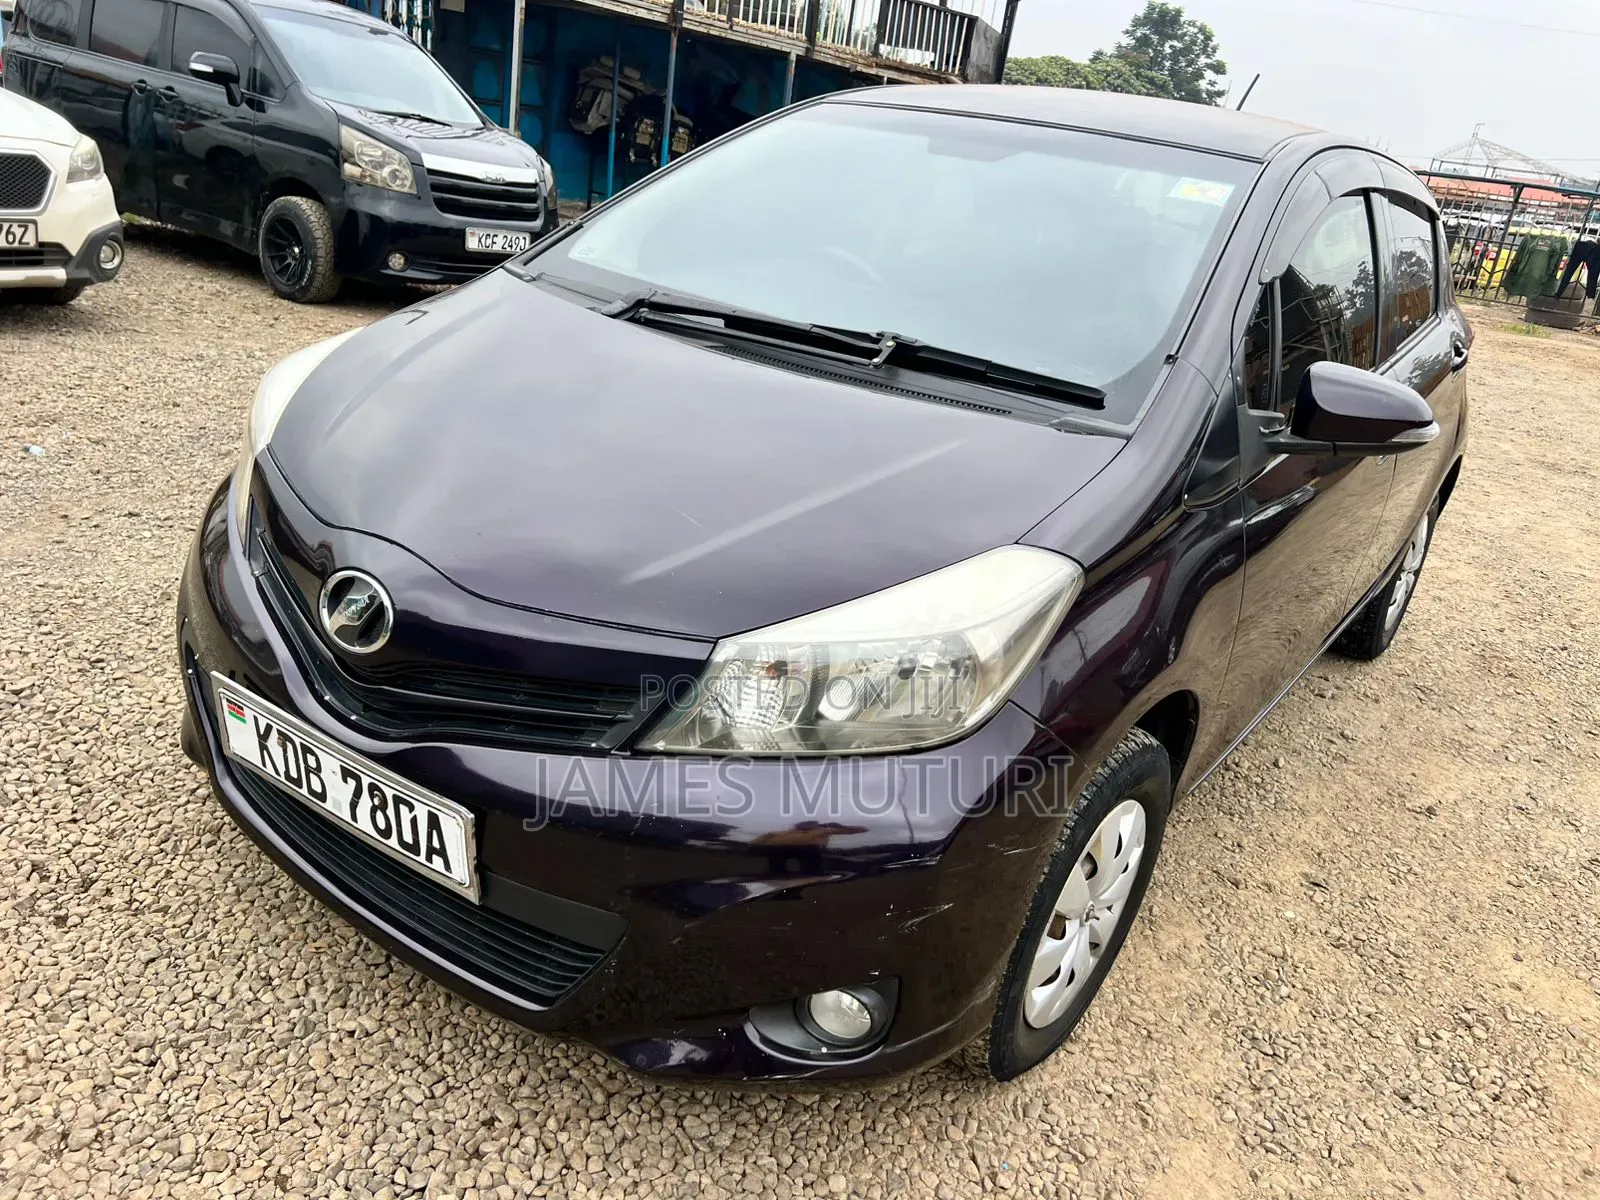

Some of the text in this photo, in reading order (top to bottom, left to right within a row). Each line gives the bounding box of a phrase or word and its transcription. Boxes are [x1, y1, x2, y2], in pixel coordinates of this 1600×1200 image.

[477, 233, 527, 251] KCF 249J
[253, 713, 453, 875] KDB 780A
